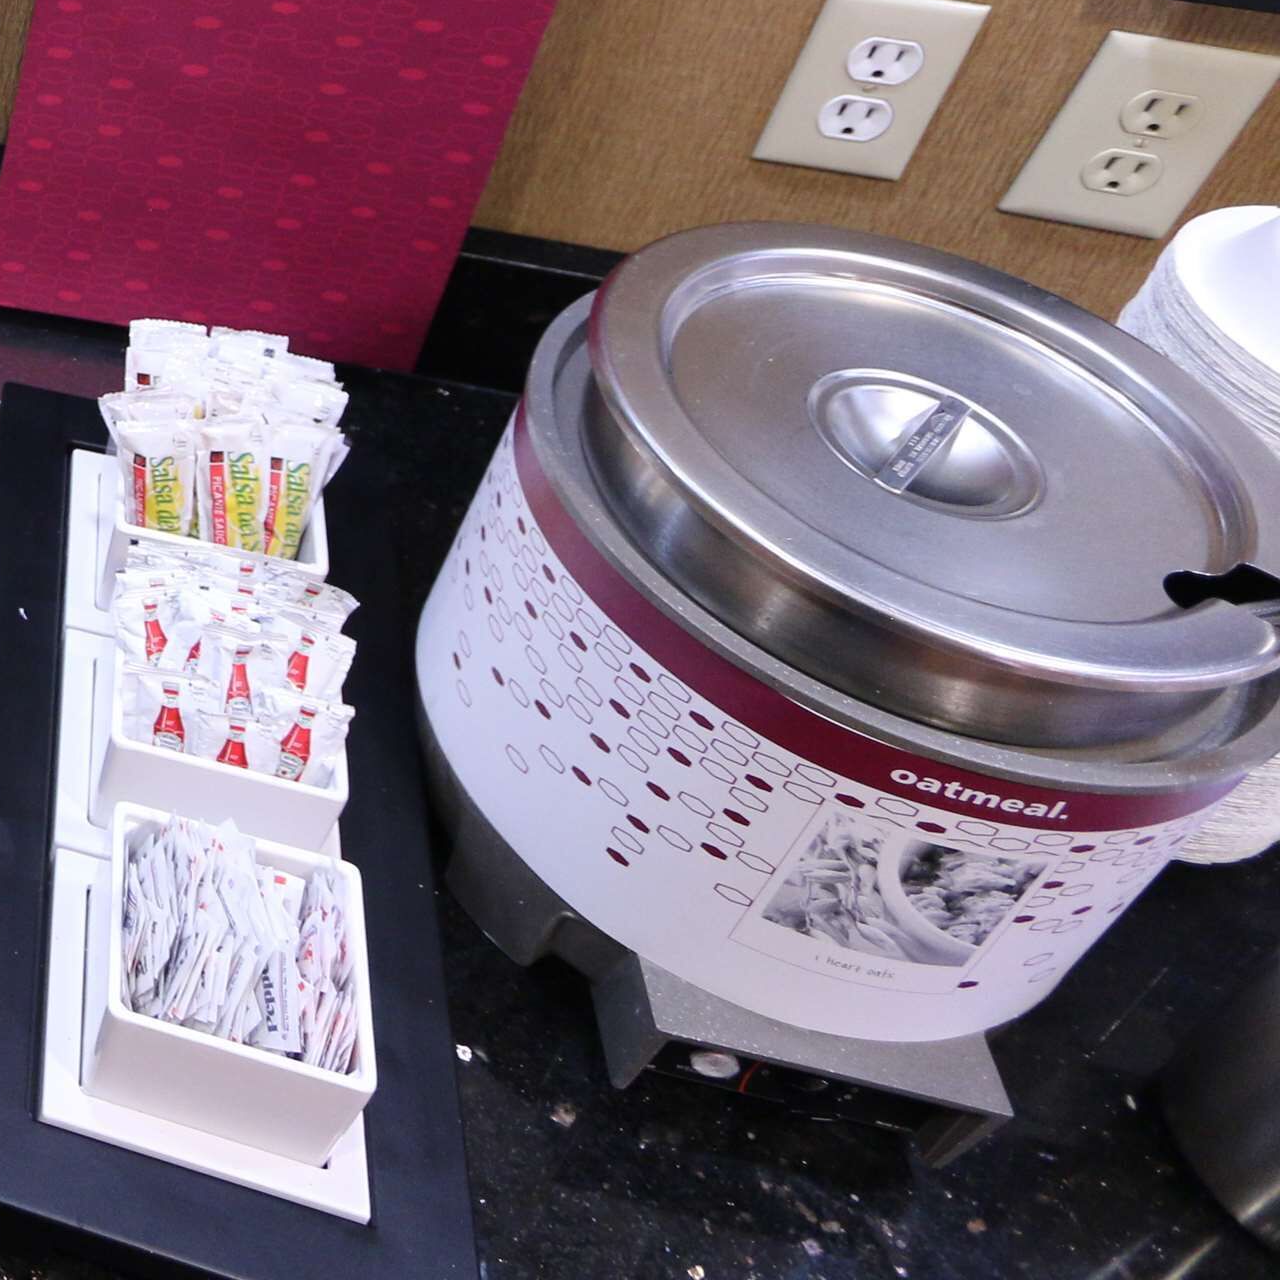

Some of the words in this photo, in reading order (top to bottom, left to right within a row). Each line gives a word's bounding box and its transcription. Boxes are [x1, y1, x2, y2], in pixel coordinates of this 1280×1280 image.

[149, 455, 177, 505] Salsa
[227, 451, 259, 505] Salsa
[286, 460, 311, 517] Salsa
[214, 518, 226, 545] SAUC
[889, 768, 1069, 820] oatmeal.
[826, 956, 862, 973] heart
